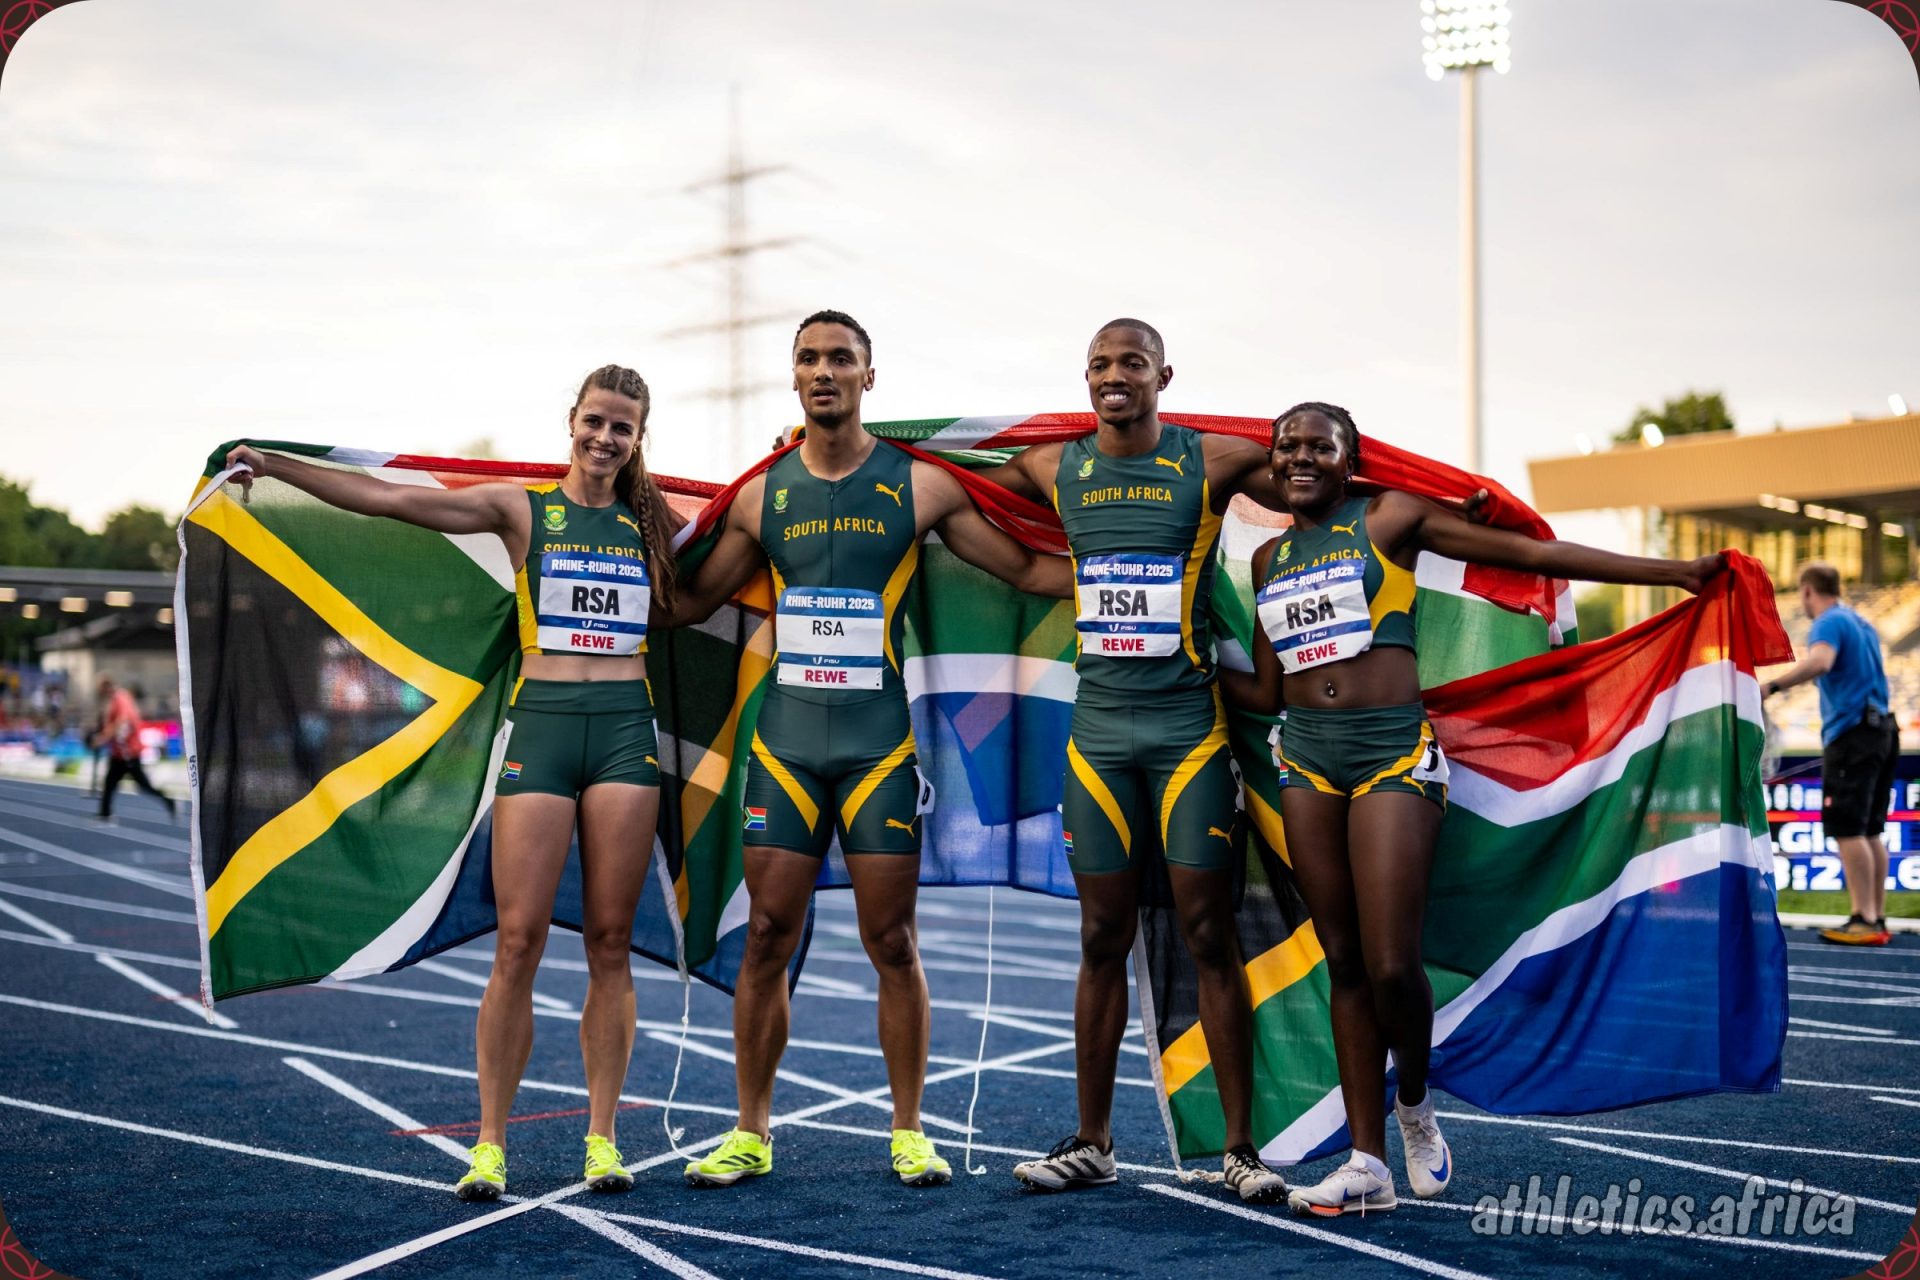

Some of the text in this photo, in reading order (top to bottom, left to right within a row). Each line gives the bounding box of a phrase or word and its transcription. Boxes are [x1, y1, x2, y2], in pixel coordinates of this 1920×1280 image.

[1082, 486, 1172, 506] SOUTH AFRICA
[783, 517, 885, 541] SOUTH AFRICA
[551, 558, 643, 578] RHINE-RUHR 2025
[1083, 563, 1174, 577] RHINE-RUHR 2025
[1266, 566, 1355, 595] RHINE-RUHR 2025
[571, 585, 620, 616] RSA
[785, 595, 875, 611] RHINE-RUHR 2025
[1099, 589, 1149, 617] RSA
[1285, 593, 1337, 631] RSA
[812, 620, 845, 637] RSA
[571, 633, 615, 650] REWE
[1102, 638, 1145, 652] REWE
[1296, 641, 1339, 665] REWE
[804, 669, 848, 684] REWE
